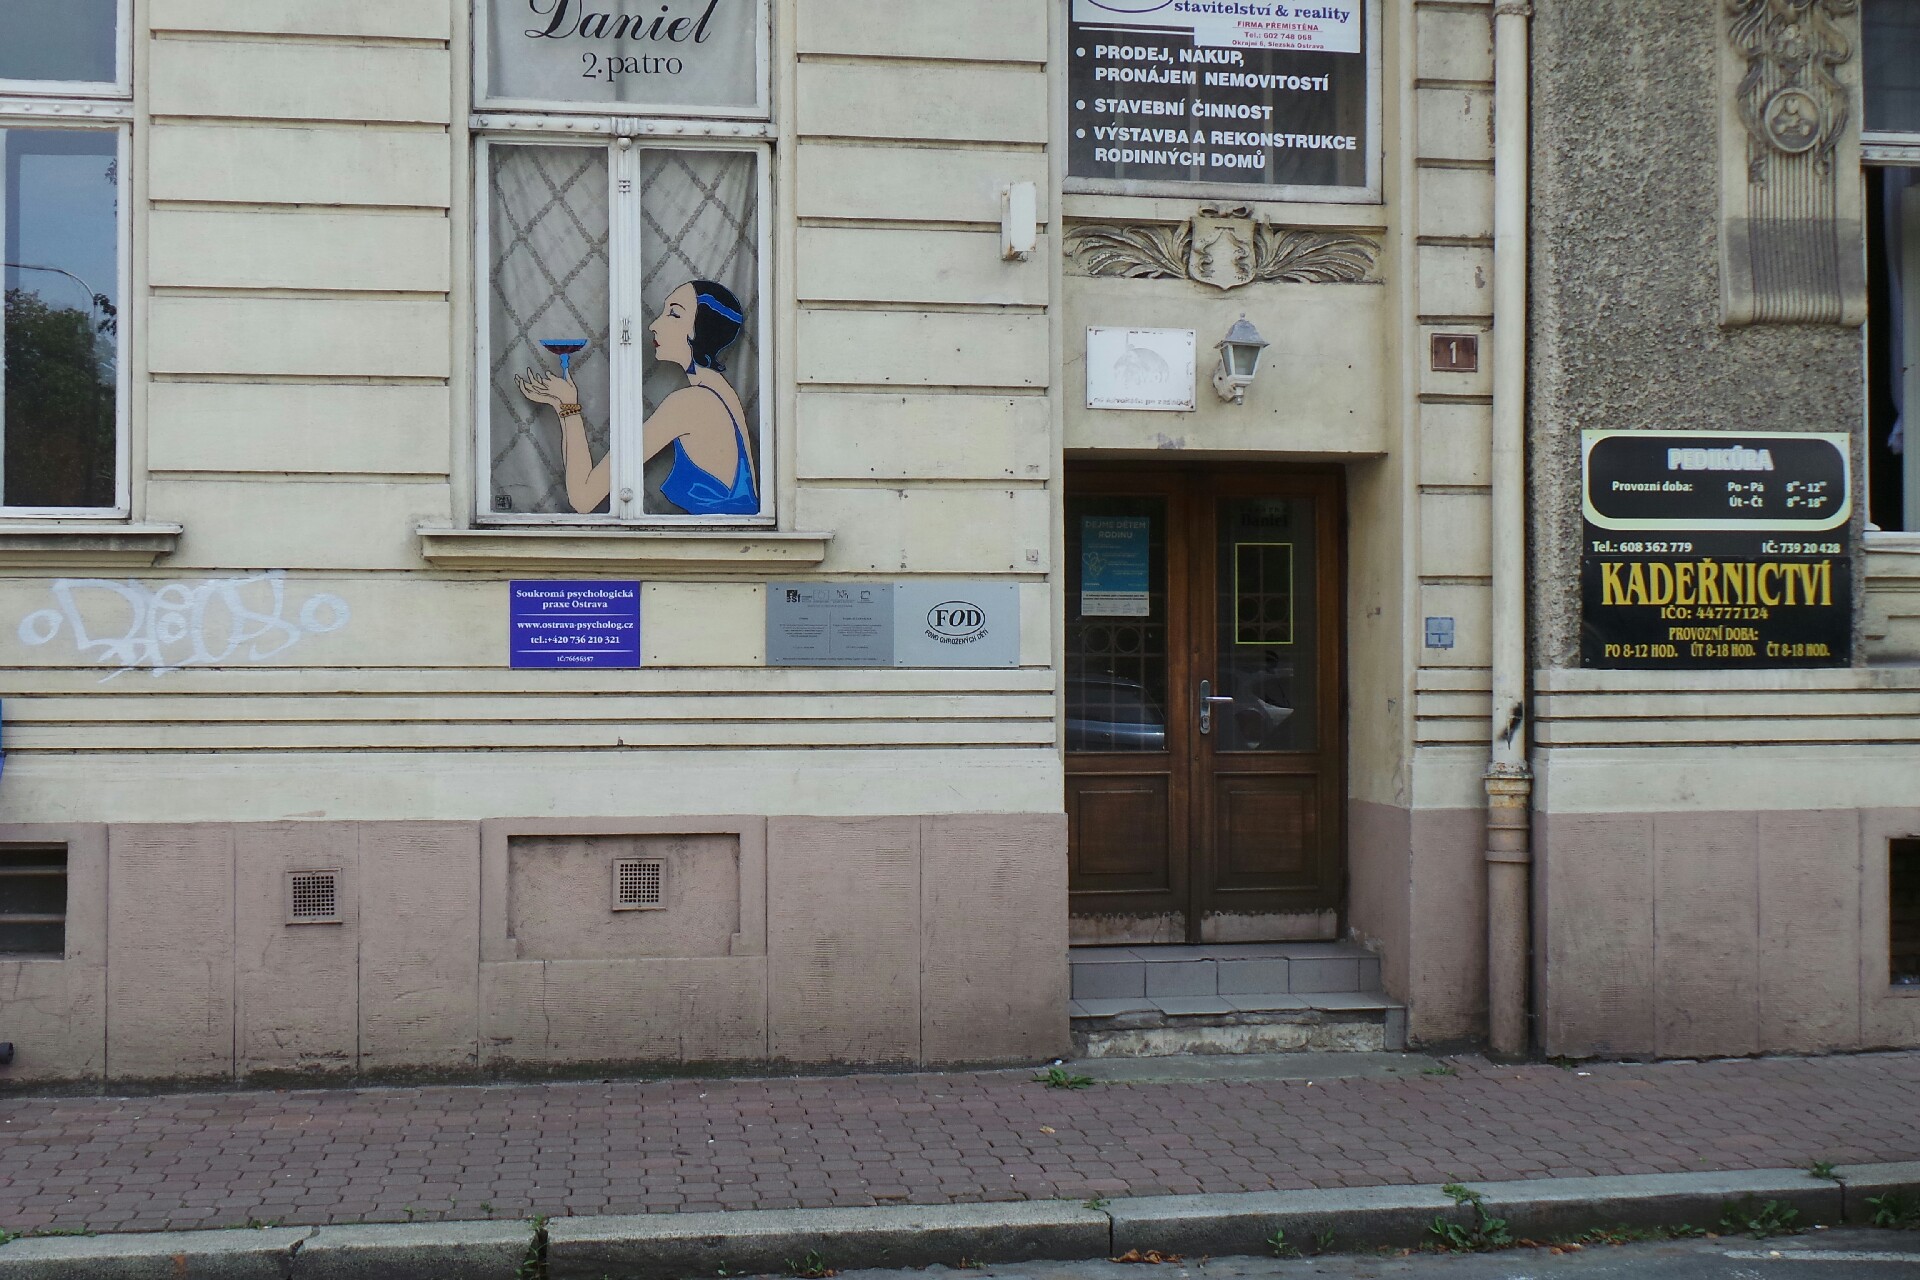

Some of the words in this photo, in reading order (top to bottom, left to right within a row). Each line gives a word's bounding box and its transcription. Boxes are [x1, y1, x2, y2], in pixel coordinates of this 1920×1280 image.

[1174, 1, 1270, 16] stavitelství
[1275, 5, 1288, 17] &
[1294, 6, 1350, 23] reality
[524, 0, 719, 44] Daniel
[1237, 20, 1263, 28] FIRMA
[1095, 45, 1174, 64] PRODEJ,
[1180, 46, 1245, 67] NÁKUP,
[1095, 66, 1197, 85] PRONÁJEM
[1205, 72, 1329, 91] NEMOVITOSTÍ
[1094, 98, 1185, 116] STAVEBNÍ
[1191, 99, 1273, 120] ČINNOST
[1094, 122, 1188, 144] VÝSTAVBA
[1193, 131, 1206, 144] A
[1211, 131, 1357, 150] REKONSTRUKCE
[1095, 147, 1205, 166] RODINNÝCH
[1211, 149, 1266, 169] DOMŮ
[1449, 341, 1456, 364] 1
[1667, 444, 1774, 471] PEDIKÚRA
[1612, 480, 1660, 492] Provozní
[1662, 480, 1693, 492] doba:
[1098, 530, 1133, 539] RODINU
[1592, 541, 1618, 552] Tel.:
[1620, 542, 1644, 552] 608
[1644, 542, 1668, 552] 362
[1670, 542, 1693, 553] 779
[1762, 541, 1778, 554] IČ:
[1780, 542, 1801, 554] 739
[1802, 543, 1818, 554] 20
[1819, 543, 1841, 554] 428
[1600, 558, 1832, 606] KADEŘNICTVÍ
[516, 589, 565, 598] Soukromá
[567, 589, 634, 600] psychologická
[542, 602, 570, 610] praxe
[572, 600, 608, 608] Ostrava
[1660, 604, 1692, 619] IČO:
[1696, 607, 1768, 620] 44777124
[516, 620, 634, 630] www.ostrava-psycholog.cz
[934, 610, 982, 627] FOD
[570, 635, 586, 644] 736
[588, 636, 603, 644] 210
[604, 636, 620, 644] 321
[1668, 625, 1723, 641] PROVOZNÍ
[1726, 627, 1759, 640] DOBA:
[1604, 644, 1621, 658] PO
[1623, 644, 1648, 658] 8-12
[1651, 644, 1678, 658] HOD.
[1690, 642, 1705, 657] ÚT
[1706, 644, 1729, 657] 8-18
[1731, 644, 1756, 657] HOD.
[1766, 641, 1780, 657] ČT
[1782, 644, 1804, 657] 8-18
[1806, 644, 1831, 657] HOD.
